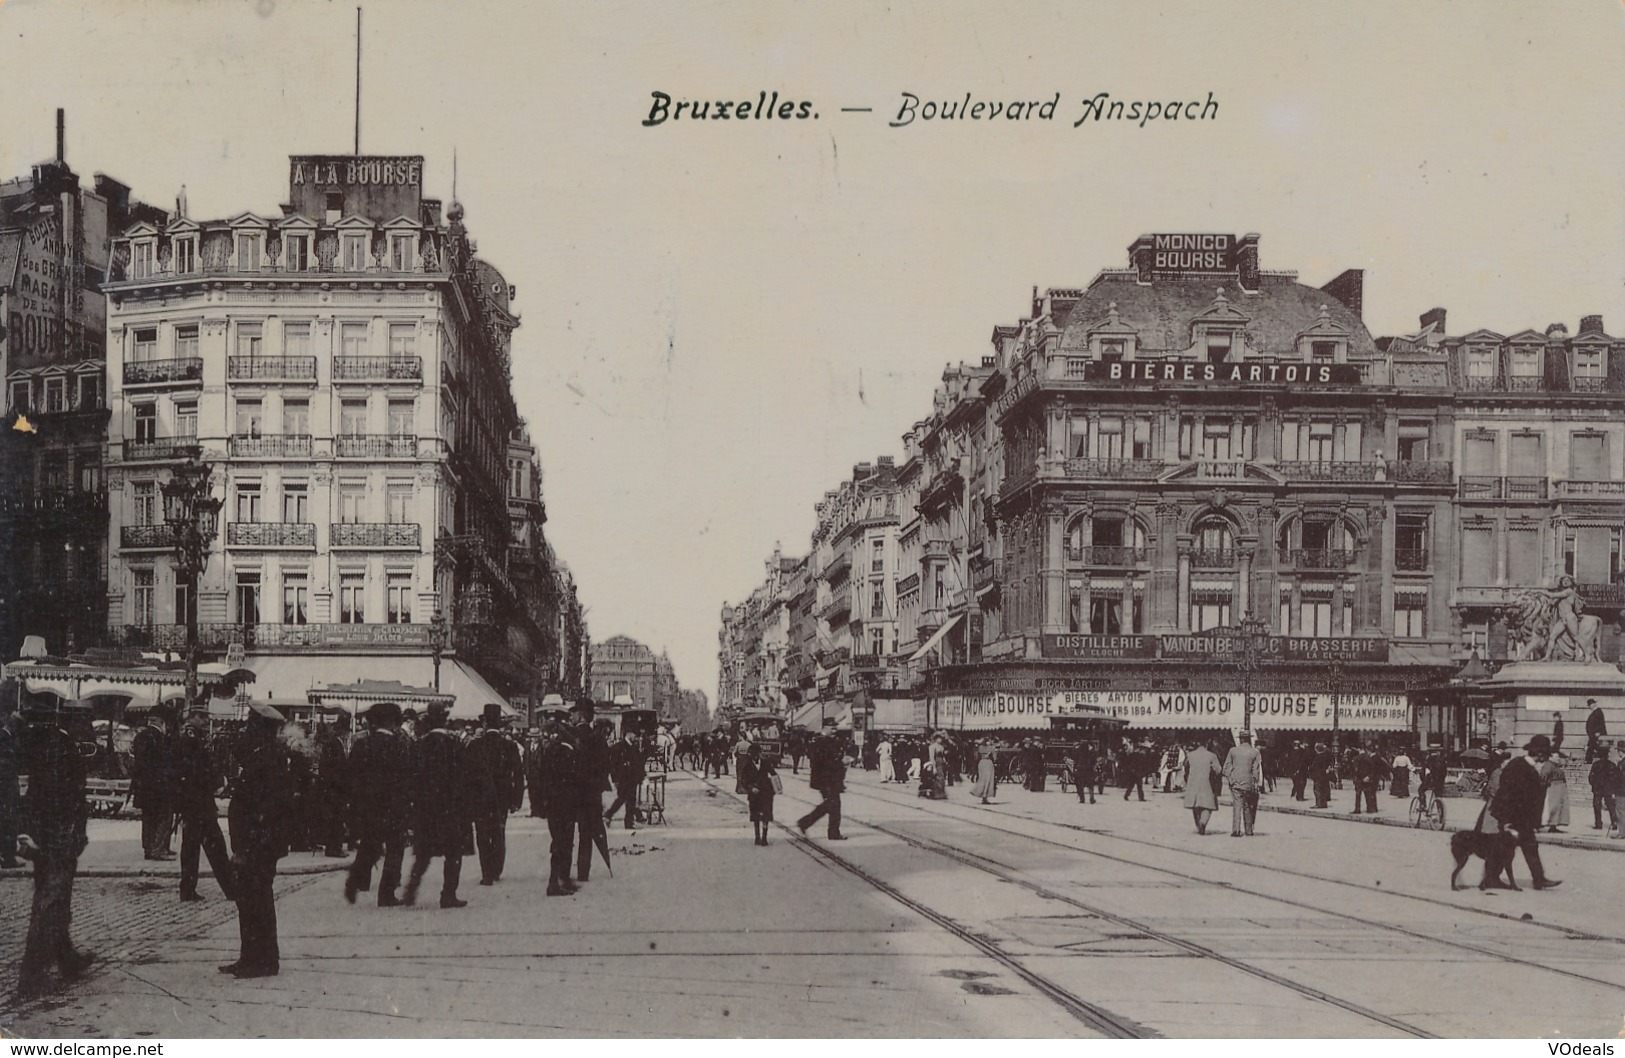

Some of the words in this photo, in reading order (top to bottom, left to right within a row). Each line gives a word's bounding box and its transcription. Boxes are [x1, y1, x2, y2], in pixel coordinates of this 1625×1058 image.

[346, 163, 420, 186] BOURSE
[1155, 235, 1227, 250] MONICO
[1155, 251, 1227, 269] BOURSE
[23, 297, 37, 311] DE
[1230, 365, 1331, 383] ARTOIS
[1056, 636, 1143, 649] DISTILLERIE
[1289, 640, 1376, 652] BRASSERIE
[1091, 649, 1124, 657] CLOCHE
[1108, 693, 1143, 703] ARTOIS
[1367, 695, 1401, 705] ARTOIS
[967, 696, 996, 717] MONICO
[999, 697, 1053, 714] BOURSE
[1095, 706, 1129, 716] NVERS
[1131, 706, 1152, 716] 1894
[1158, 696, 1230, 713] MONICO
[1249, 697, 1318, 714] BOURSE
[1337, 708, 1352, 718] RIX
[1355, 708, 1387, 718] ANVERS
[1389, 709, 1405, 718] 1894
